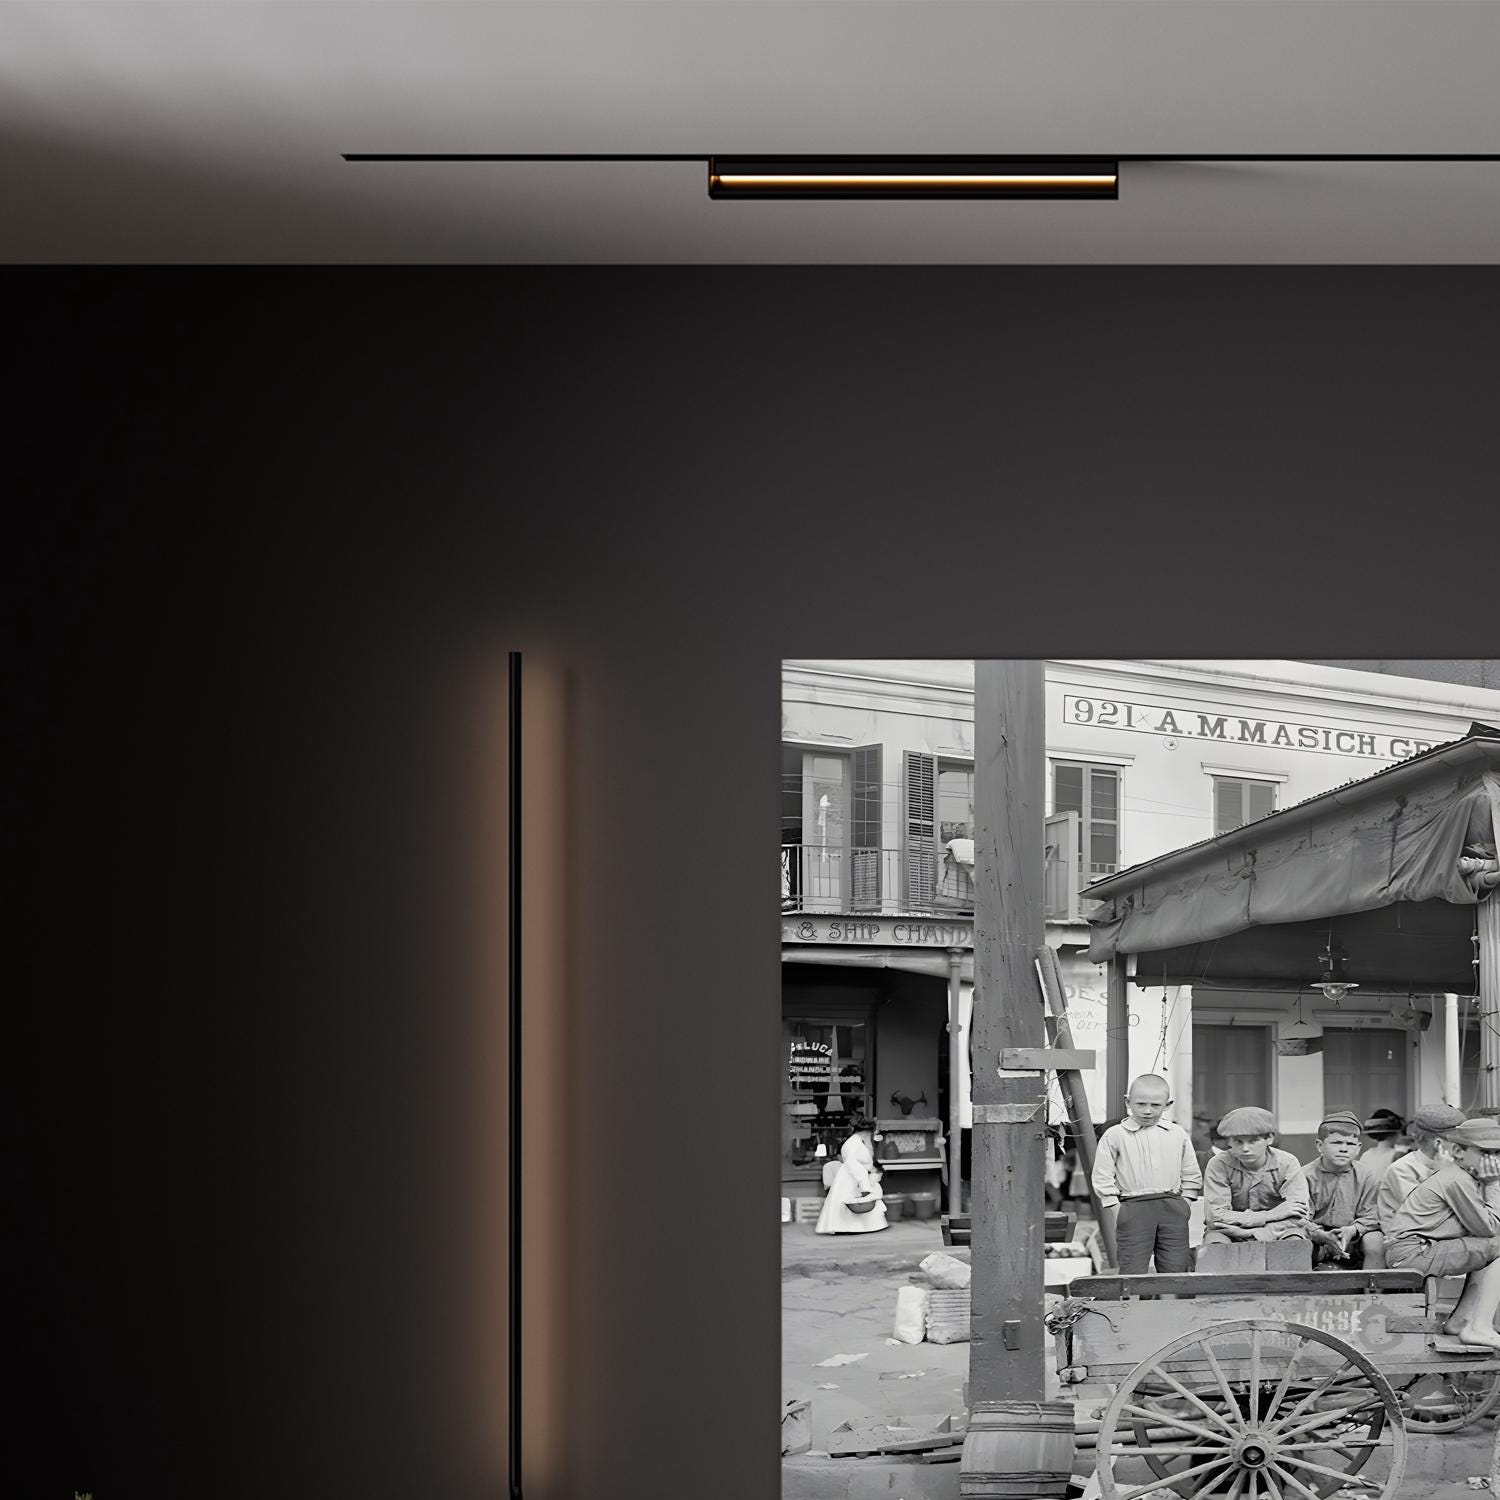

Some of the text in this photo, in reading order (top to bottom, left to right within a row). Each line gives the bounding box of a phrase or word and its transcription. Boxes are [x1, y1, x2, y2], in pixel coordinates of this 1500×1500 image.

[1074, 698, 1137, 728] 921
[796, 921, 818, 941] &
[827, 922, 880, 942] SHIP
